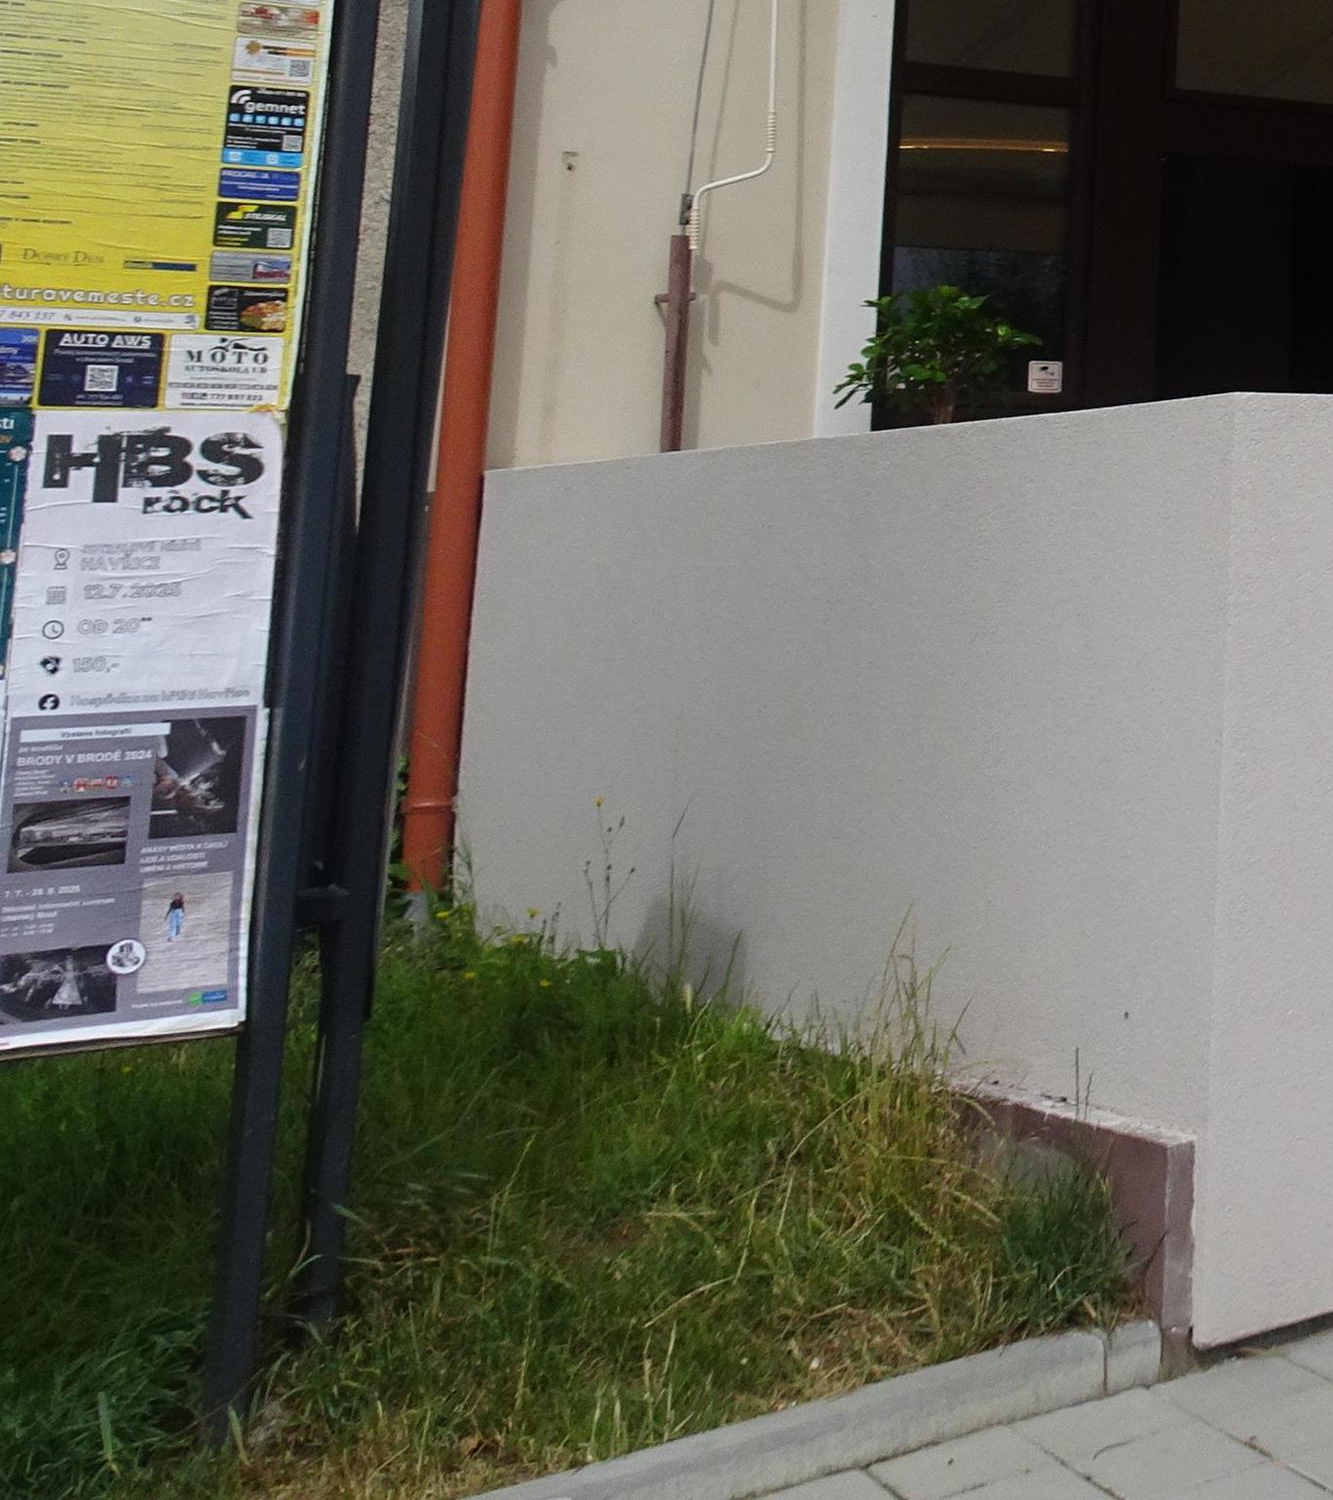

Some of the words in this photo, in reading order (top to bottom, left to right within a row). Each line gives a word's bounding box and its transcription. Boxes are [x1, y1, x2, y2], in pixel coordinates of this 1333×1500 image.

[244, 101, 306, 115] gemnet
[59, 333, 109, 347] AUTO
[111, 335, 152, 348] AWS
[185, 350, 269, 366] MOTO
[42, 430, 264, 503] HBS
[142, 490, 254, 519] rock
[17, 754, 63, 767] BRODY
[65, 754, 77, 765] V
